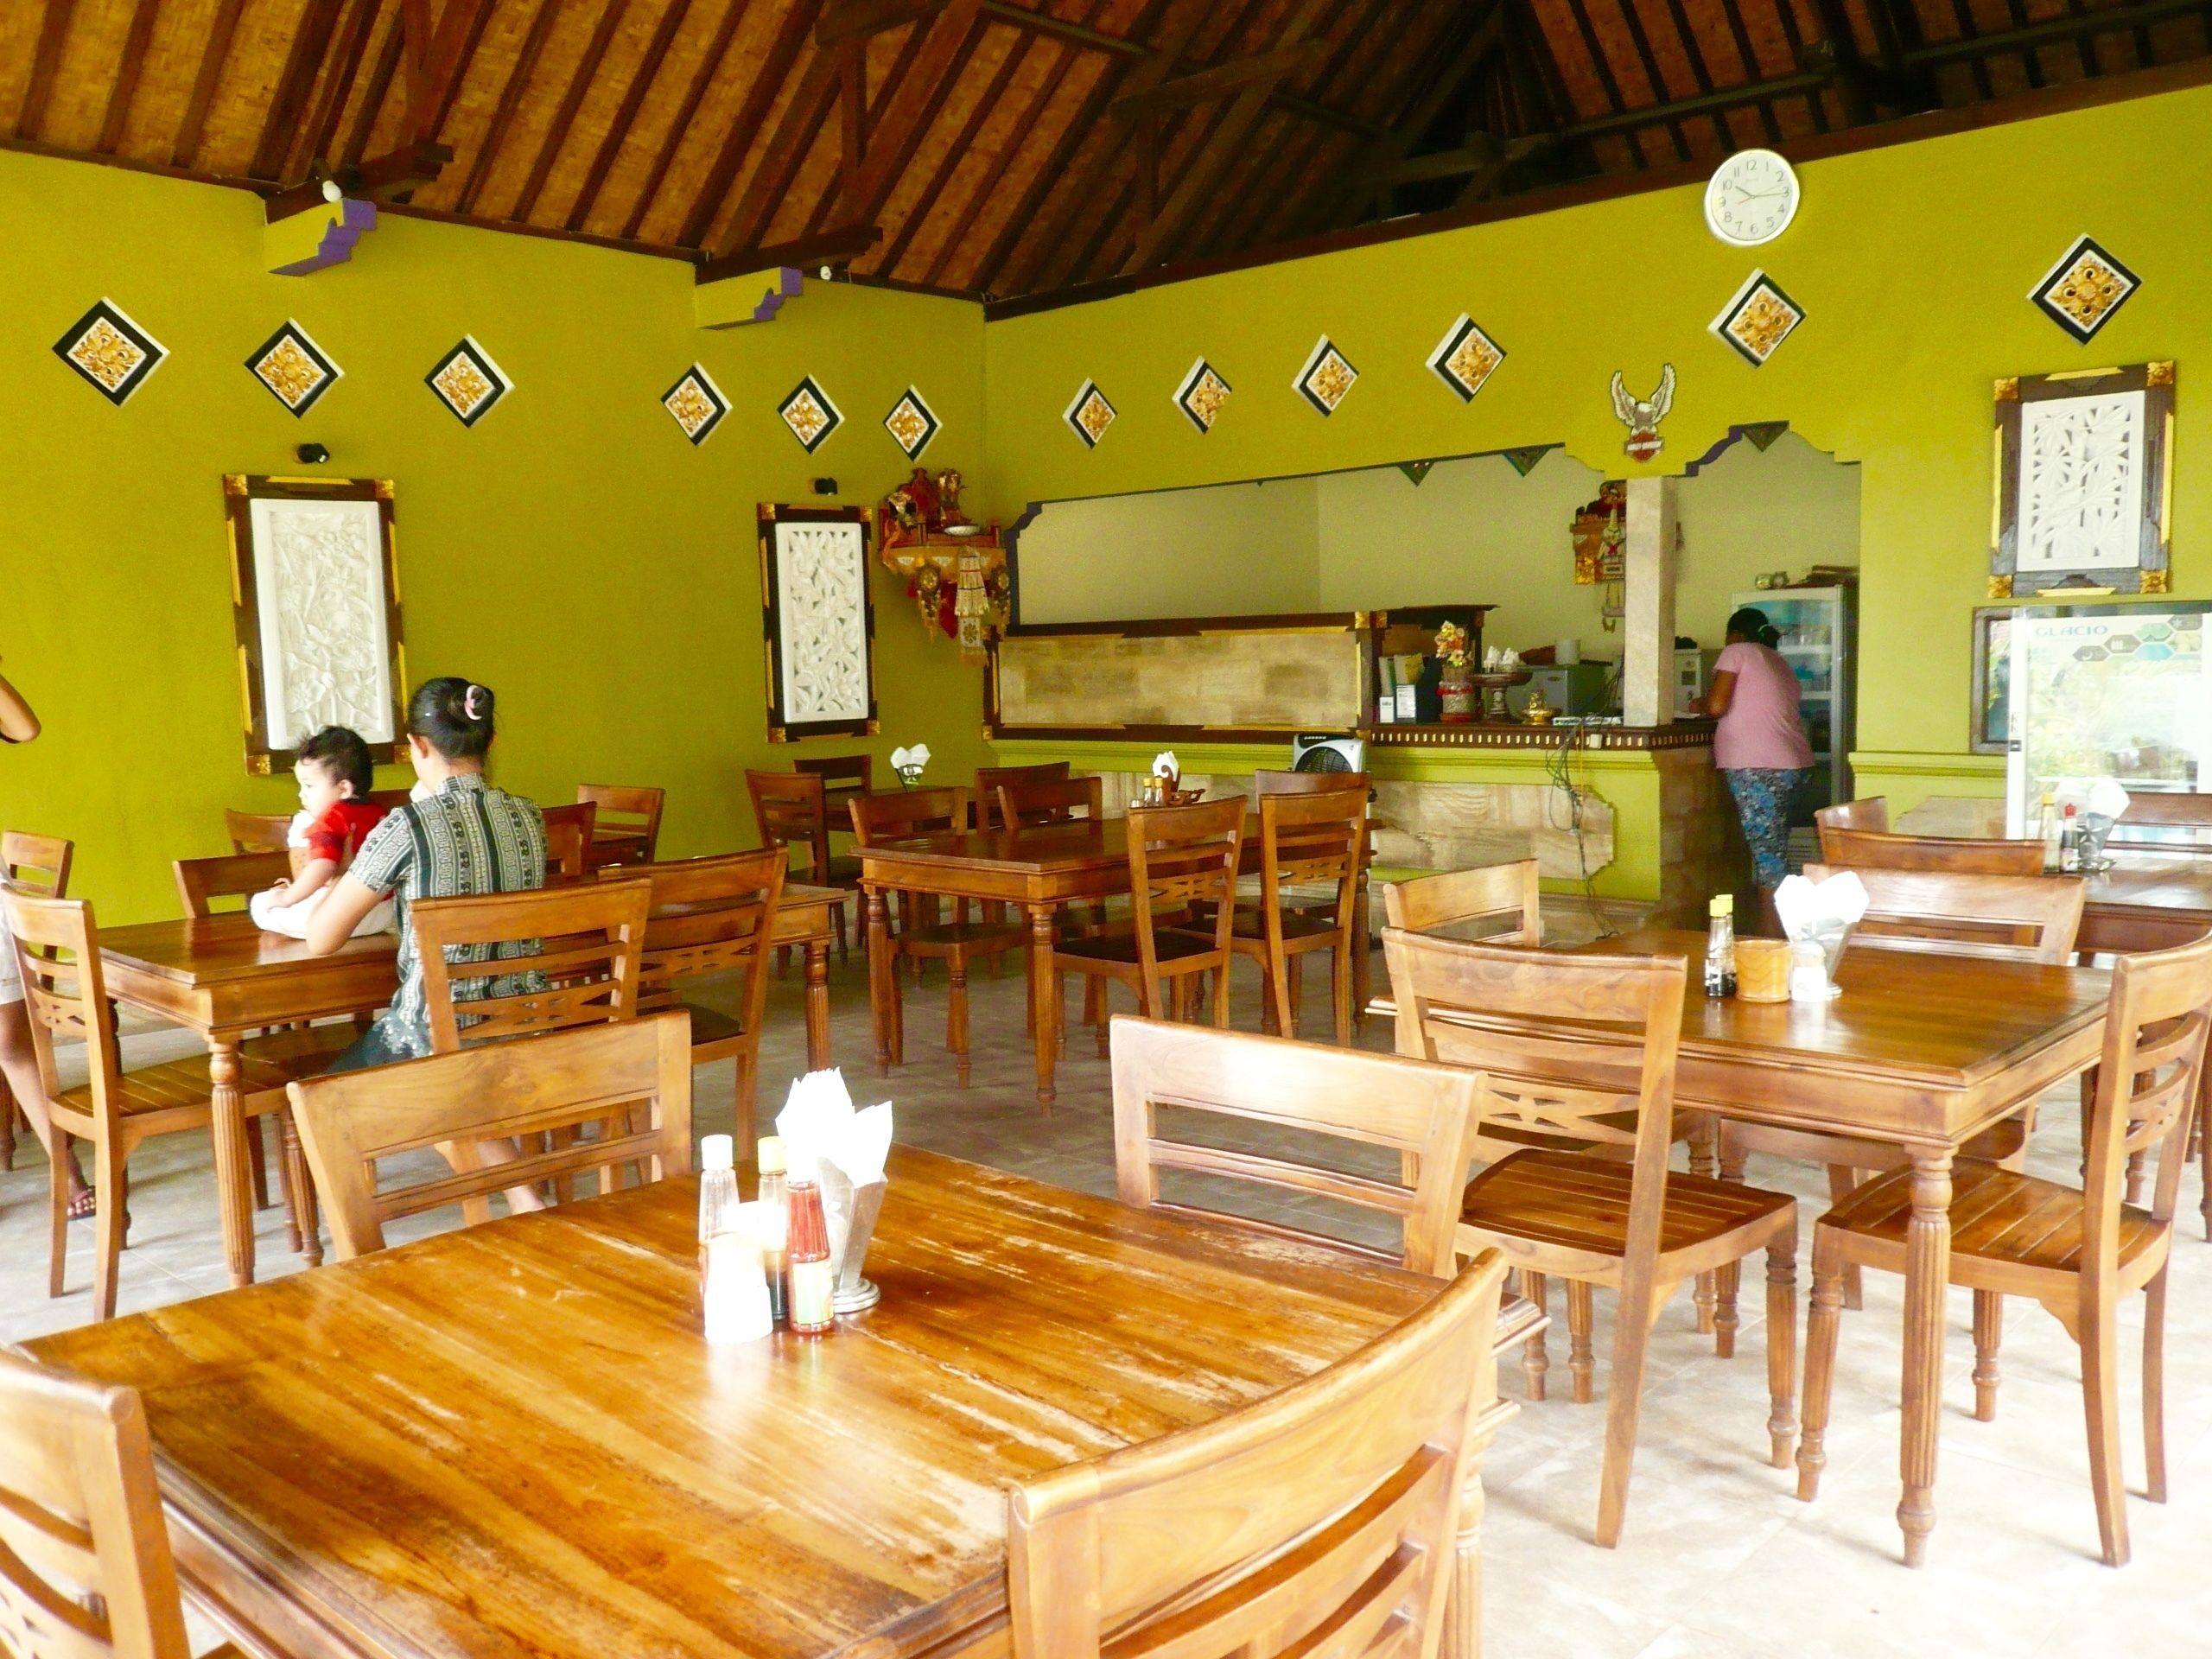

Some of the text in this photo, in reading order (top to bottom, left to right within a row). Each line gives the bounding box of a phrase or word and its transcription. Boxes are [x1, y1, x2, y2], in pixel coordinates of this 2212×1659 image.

[1746, 160, 1756, 170] 12
[1734, 167, 1740, 177] 11
[1776, 171, 1783, 182] 2
[1723, 180, 1732, 190] 10
[1783, 187, 1789, 197] 3
[1777, 203, 1785, 213] 4
[1725, 212, 1732, 223] 8
[1767, 217, 1775, 227] 5
[1735, 221, 1743, 232] 7
[1750, 223, 1758, 234] 6
[2035, 625, 2108, 637] GLACIO
